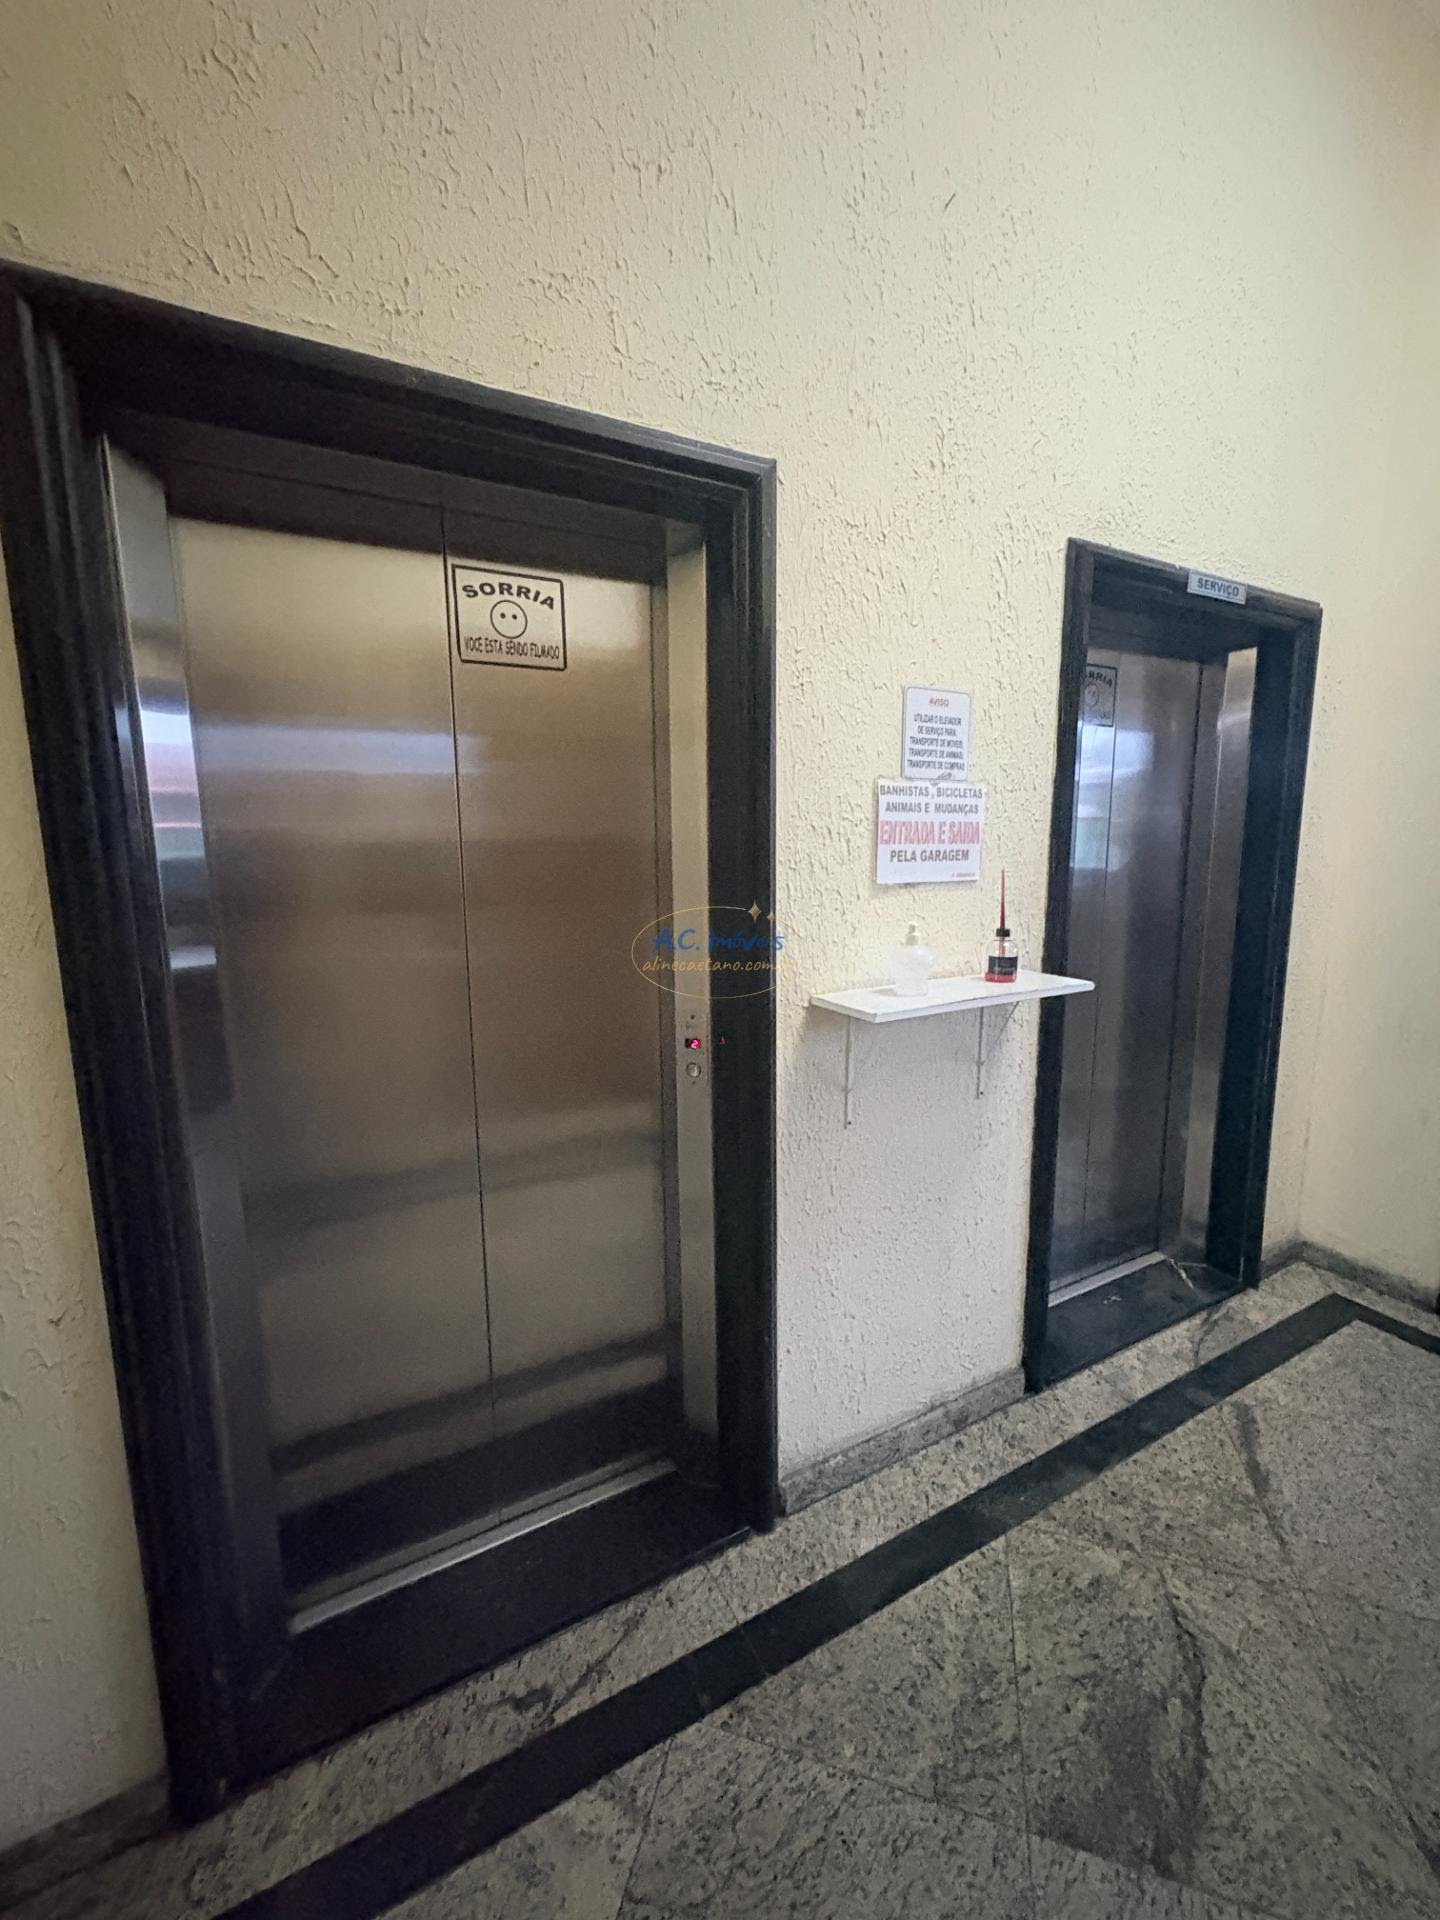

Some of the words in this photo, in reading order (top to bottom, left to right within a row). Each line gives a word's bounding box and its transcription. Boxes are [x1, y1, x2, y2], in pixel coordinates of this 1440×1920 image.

[1197, 577, 1240, 599] SERVIÇO
[462, 582, 555, 610] SORRIA
[505, 640, 528, 657] SENDO
[530, 643, 560, 660] FILMADO
[928, 698, 949, 707] AVISO
[917, 725, 924, 734] DE
[909, 736, 938, 747] TRANSPORTE
[909, 748, 938, 759] TRANSPORTE
[907, 759, 936, 769] TRANSPORTE
[936, 787, 983, 799] BICICLETAS
[885, 802, 922, 813] ANIMAIS
[924, 803, 930, 813] E
[934, 803, 979, 816] MUDANÇAS
[880, 820, 935, 845] ENTRADA
[938, 821, 947, 845] E
[890, 850, 917, 862] PELA
[920, 849, 969, 862] GARAGEM
